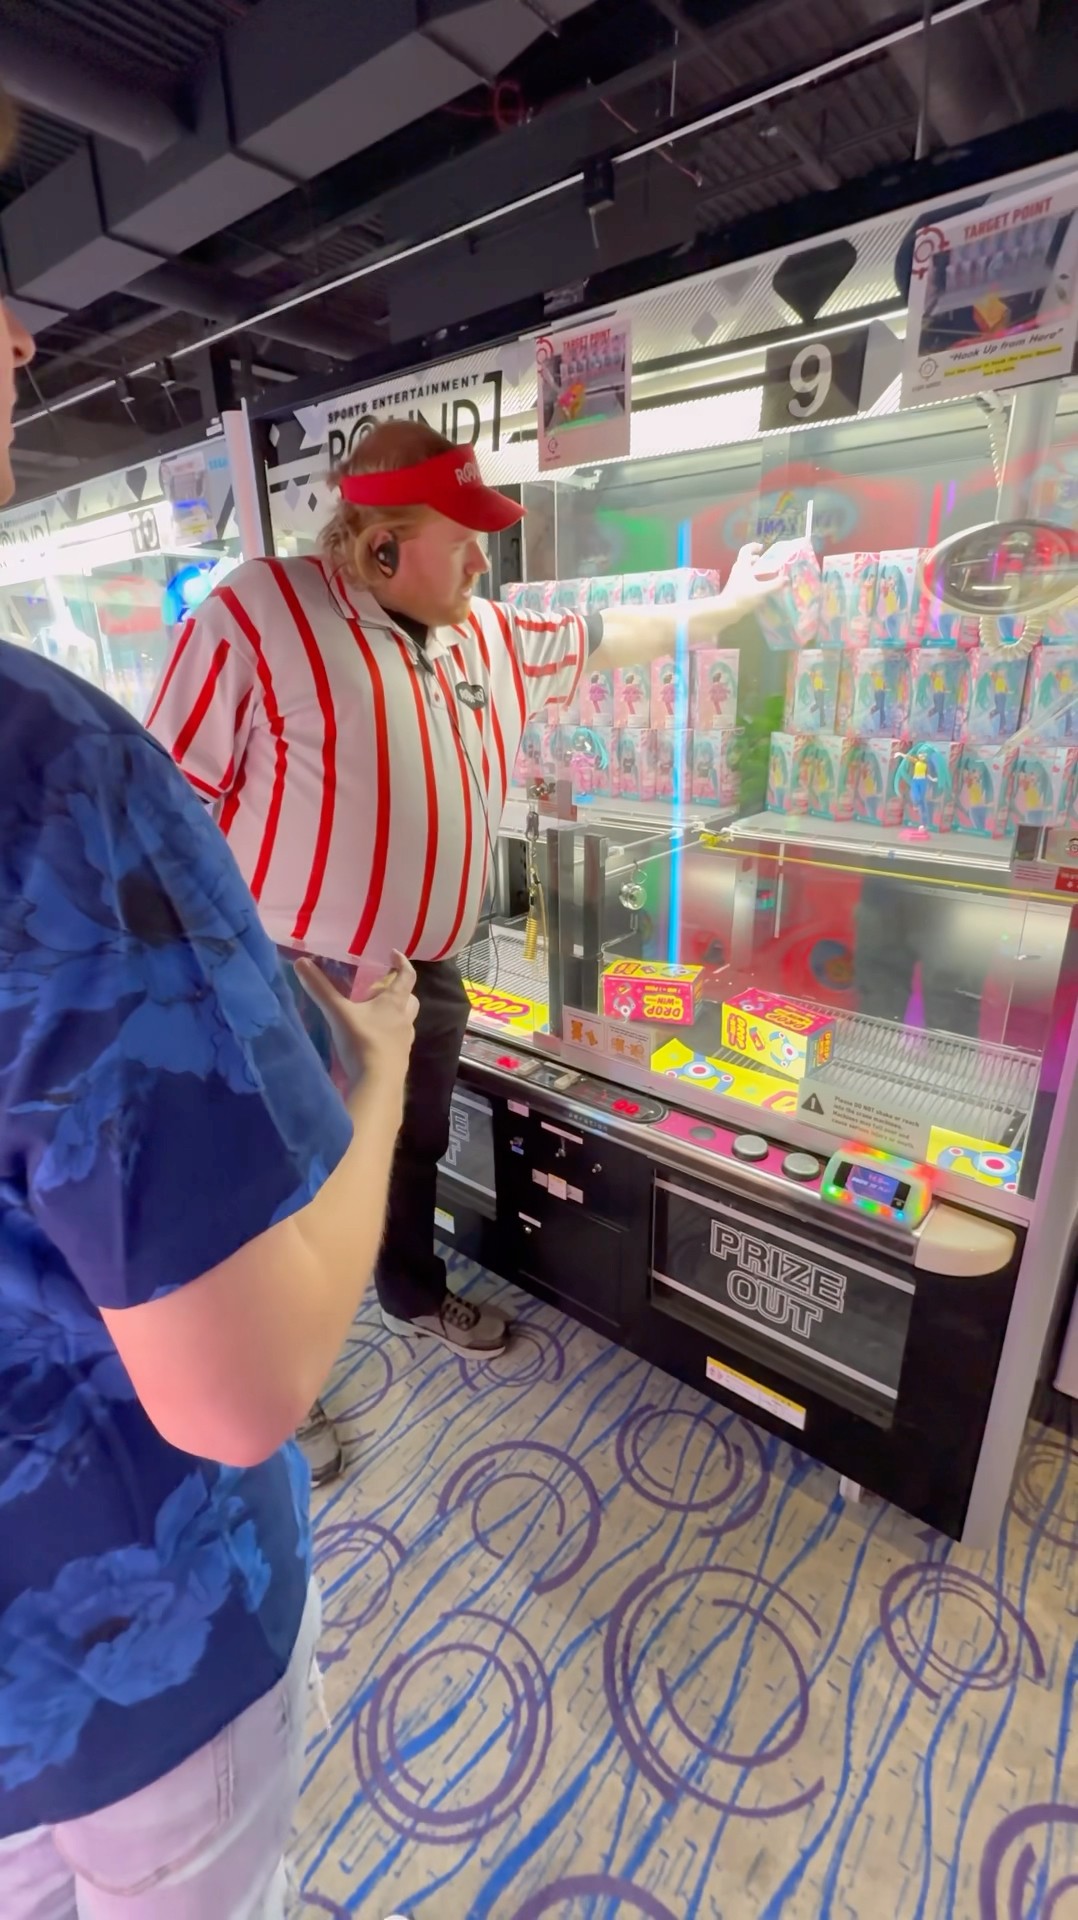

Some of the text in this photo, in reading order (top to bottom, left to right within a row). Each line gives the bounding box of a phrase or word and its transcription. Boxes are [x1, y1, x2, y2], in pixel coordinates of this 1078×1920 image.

[964, 197, 1053, 239] TARGET POINT
[563, 328, 611, 349] TARGET POINT
[983, 345, 998, 356] Up
[1000, 339, 1026, 350] from
[787, 343, 832, 418] 9
[328, 374, 480, 424] SPORTS ENTERTAINMENT
[646, 1005, 682, 1018] DROP
[657, 996, 675, 1005] WIN
[832, 1110, 858, 1123] Machines
[834, 1095, 853, 1106] Please
[863, 1105, 875, 1113] NOT
[876, 1110, 893, 1119] shake
[902, 1118, 920, 1128] reach
[710, 1219, 847, 1314] PRIZE
[727, 1270, 823, 1338] OUT
